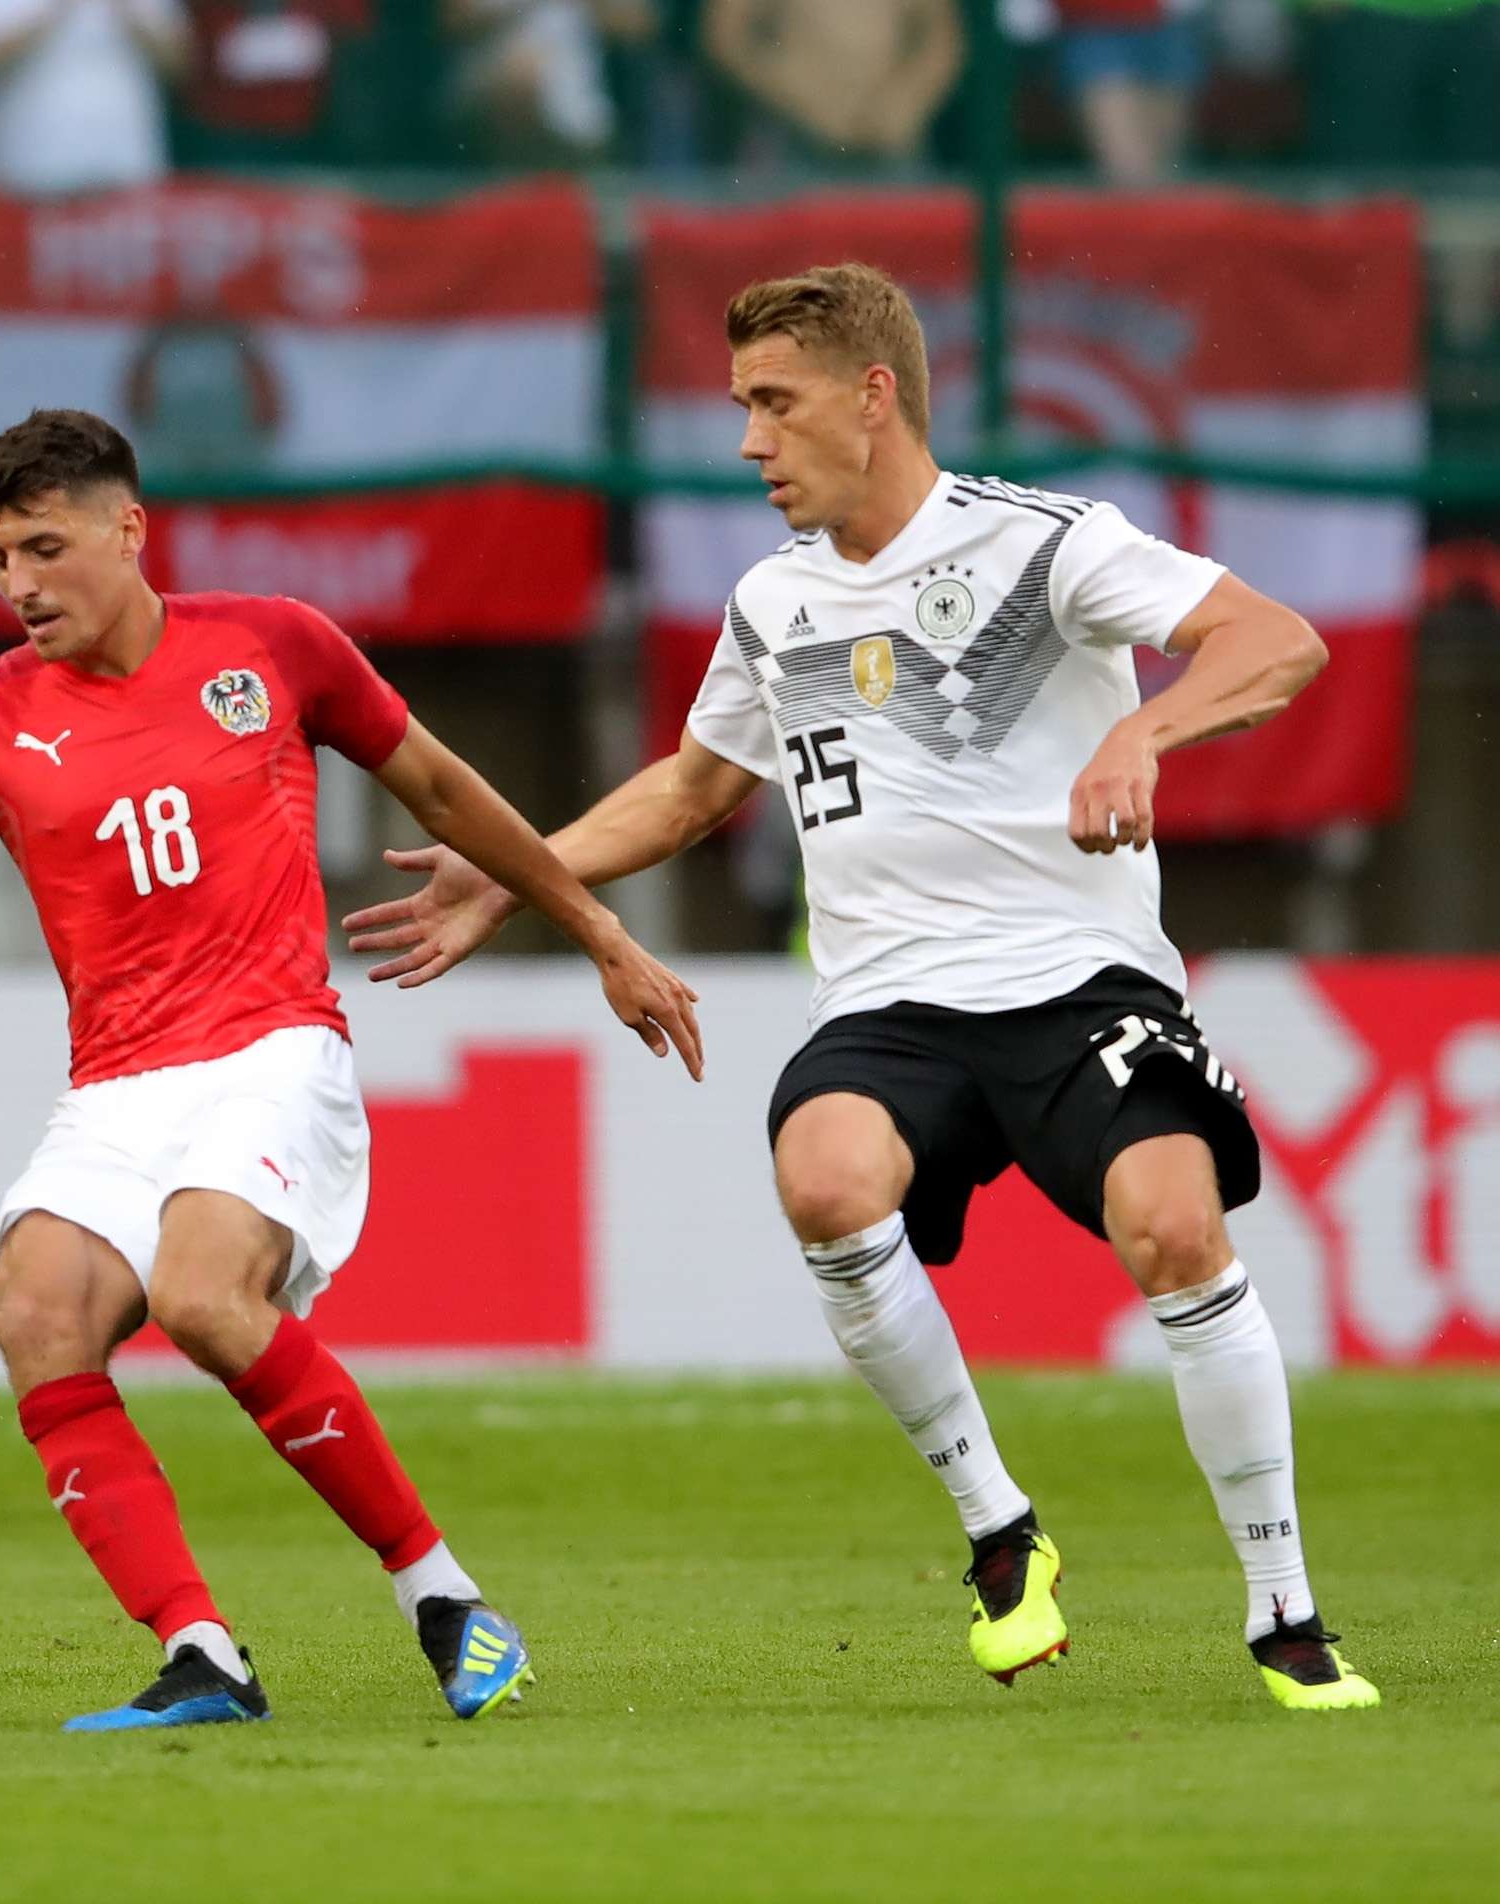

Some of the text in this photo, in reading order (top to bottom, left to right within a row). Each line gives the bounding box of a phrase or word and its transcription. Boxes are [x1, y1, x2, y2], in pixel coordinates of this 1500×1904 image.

[785, 725, 862, 832] 25
[94, 784, 202, 896] 18
[928, 1437, 969, 1468] DFB
[1247, 1519, 1292, 1540] DFB
